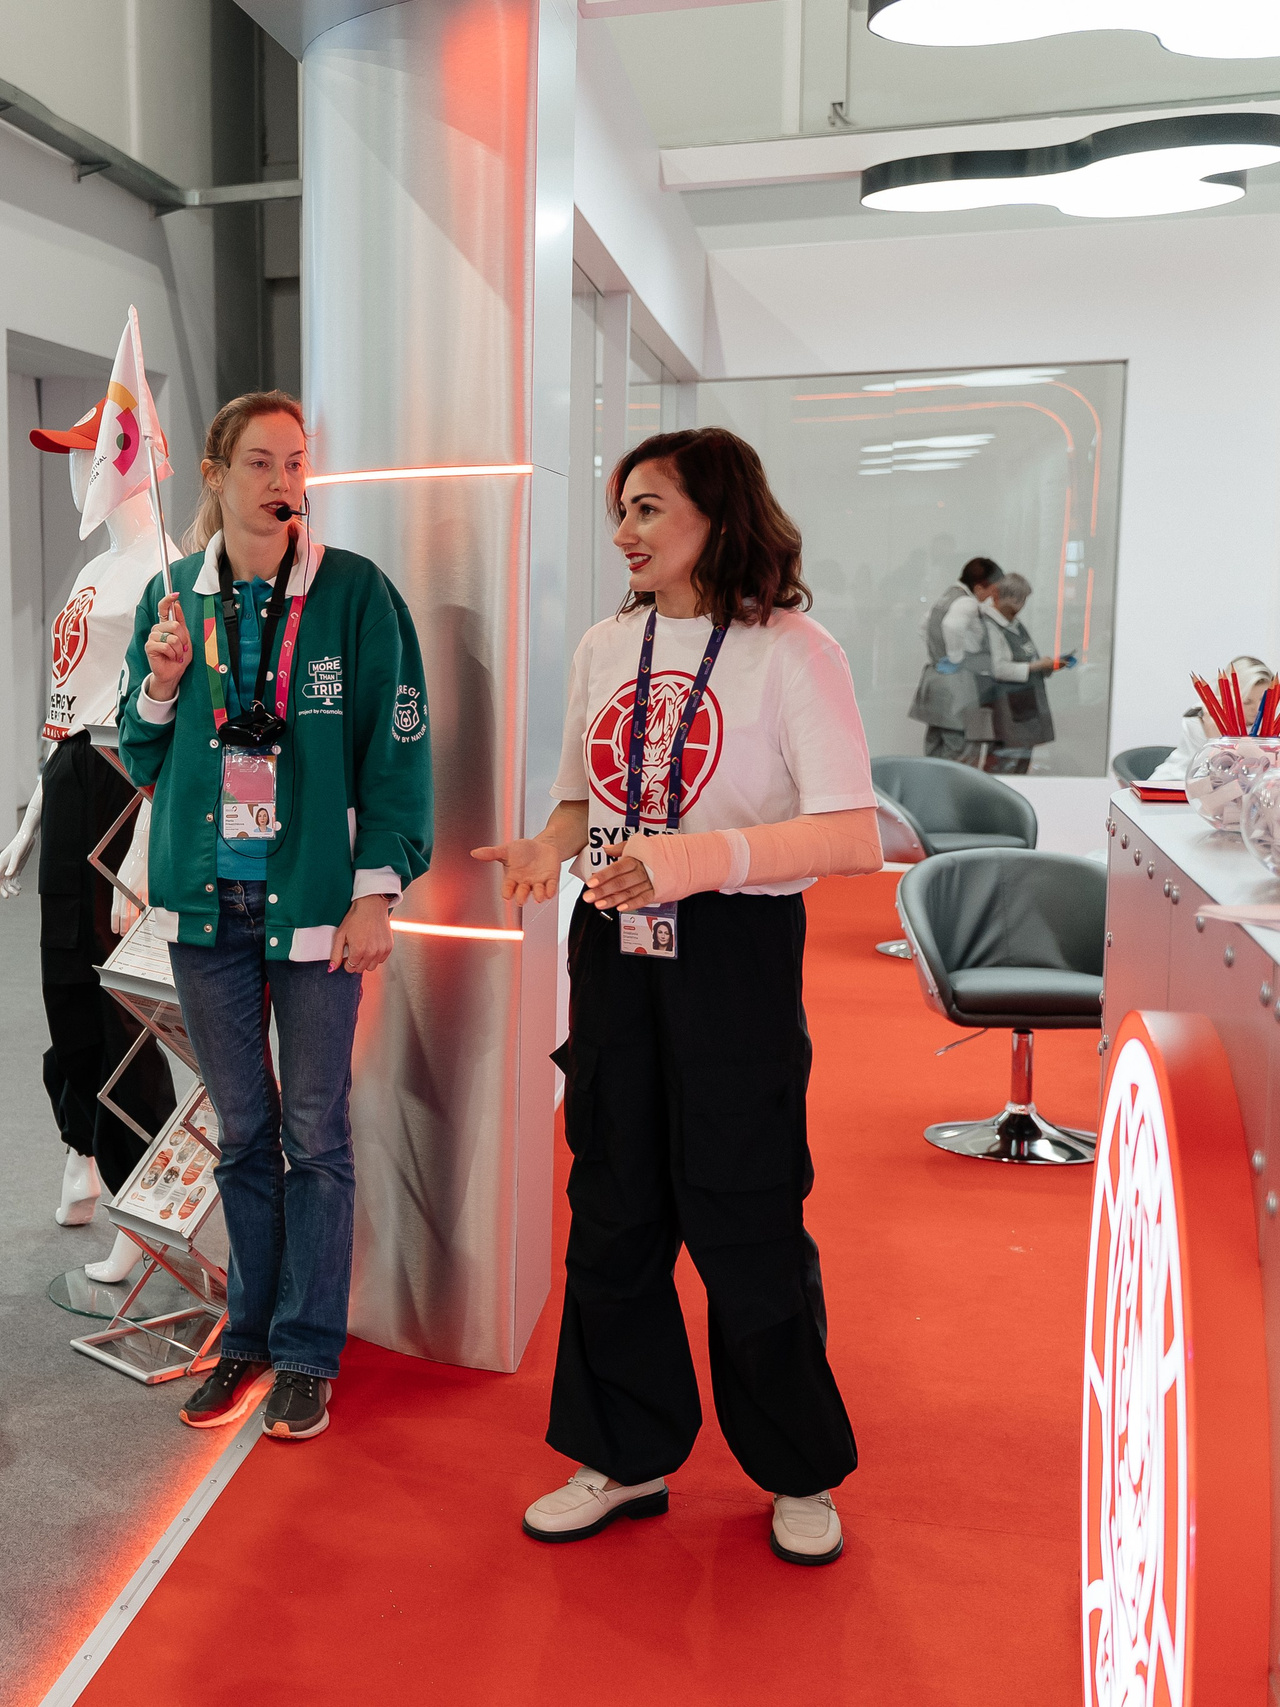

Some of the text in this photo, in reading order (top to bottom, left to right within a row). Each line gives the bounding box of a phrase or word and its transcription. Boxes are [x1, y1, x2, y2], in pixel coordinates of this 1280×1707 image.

[312, 660, 341, 672] MORE
[318, 673, 336, 681] THAN
[312, 683, 342, 695] TRIP
[298, 708, 313, 716] project
